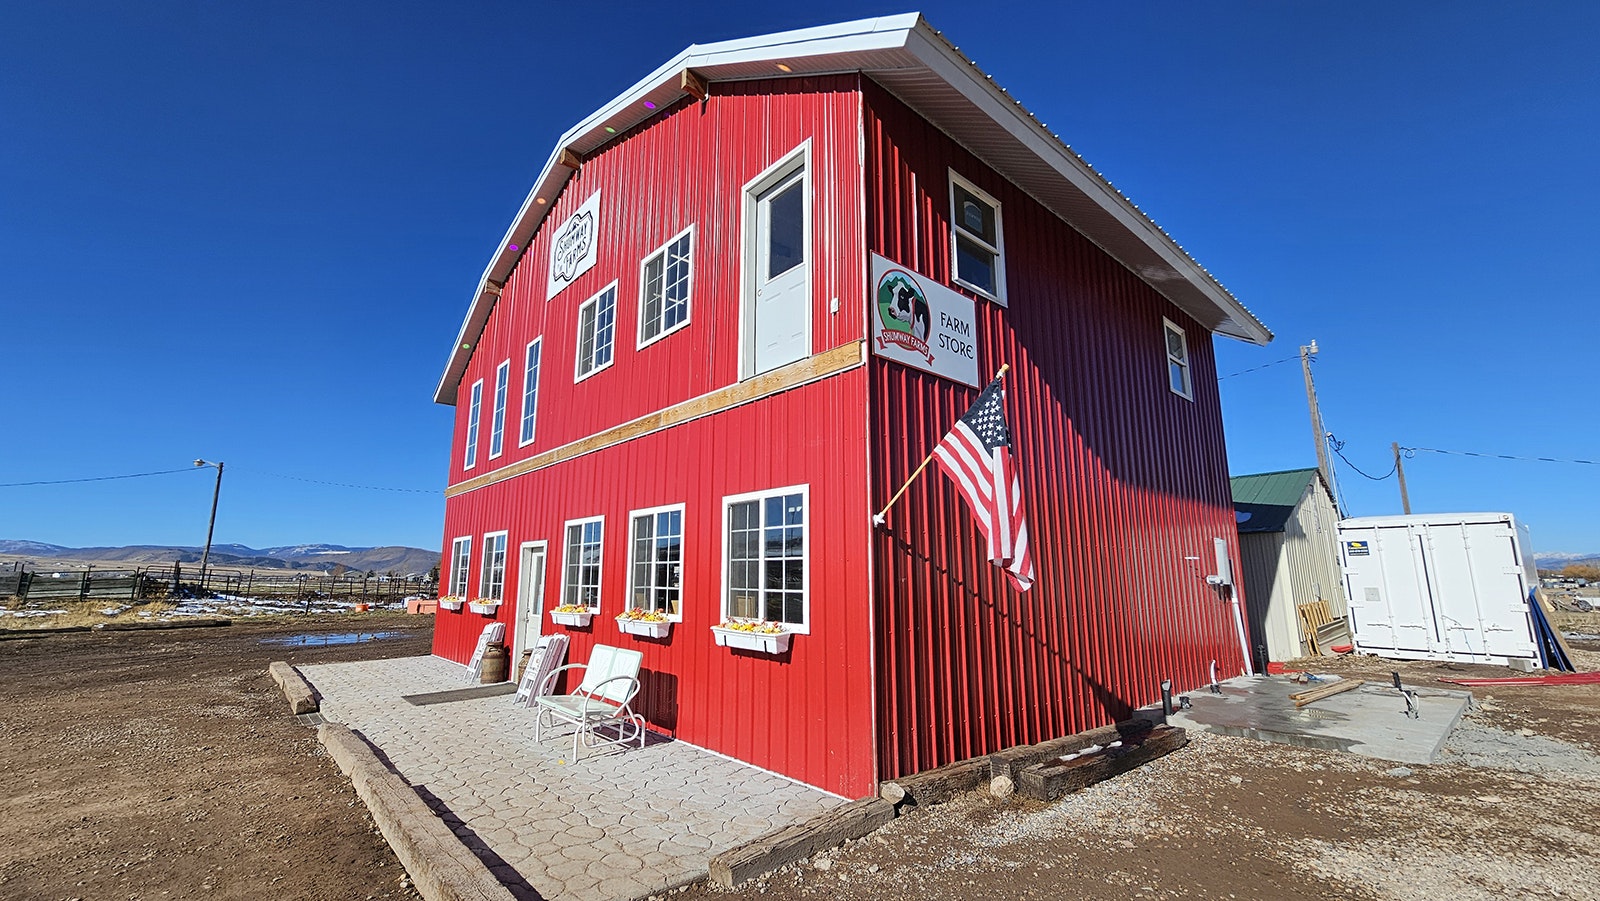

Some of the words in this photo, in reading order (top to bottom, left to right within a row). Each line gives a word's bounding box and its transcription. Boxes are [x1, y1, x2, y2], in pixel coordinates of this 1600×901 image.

[558, 222, 587, 261] SHUMWAY
[565, 238, 586, 273] FARMS
[941, 312, 970, 337] FARM
[883, 332, 911, 344] SHUMWAY
[911, 336, 929, 355] FARMS
[938, 333, 974, 359] STORE
